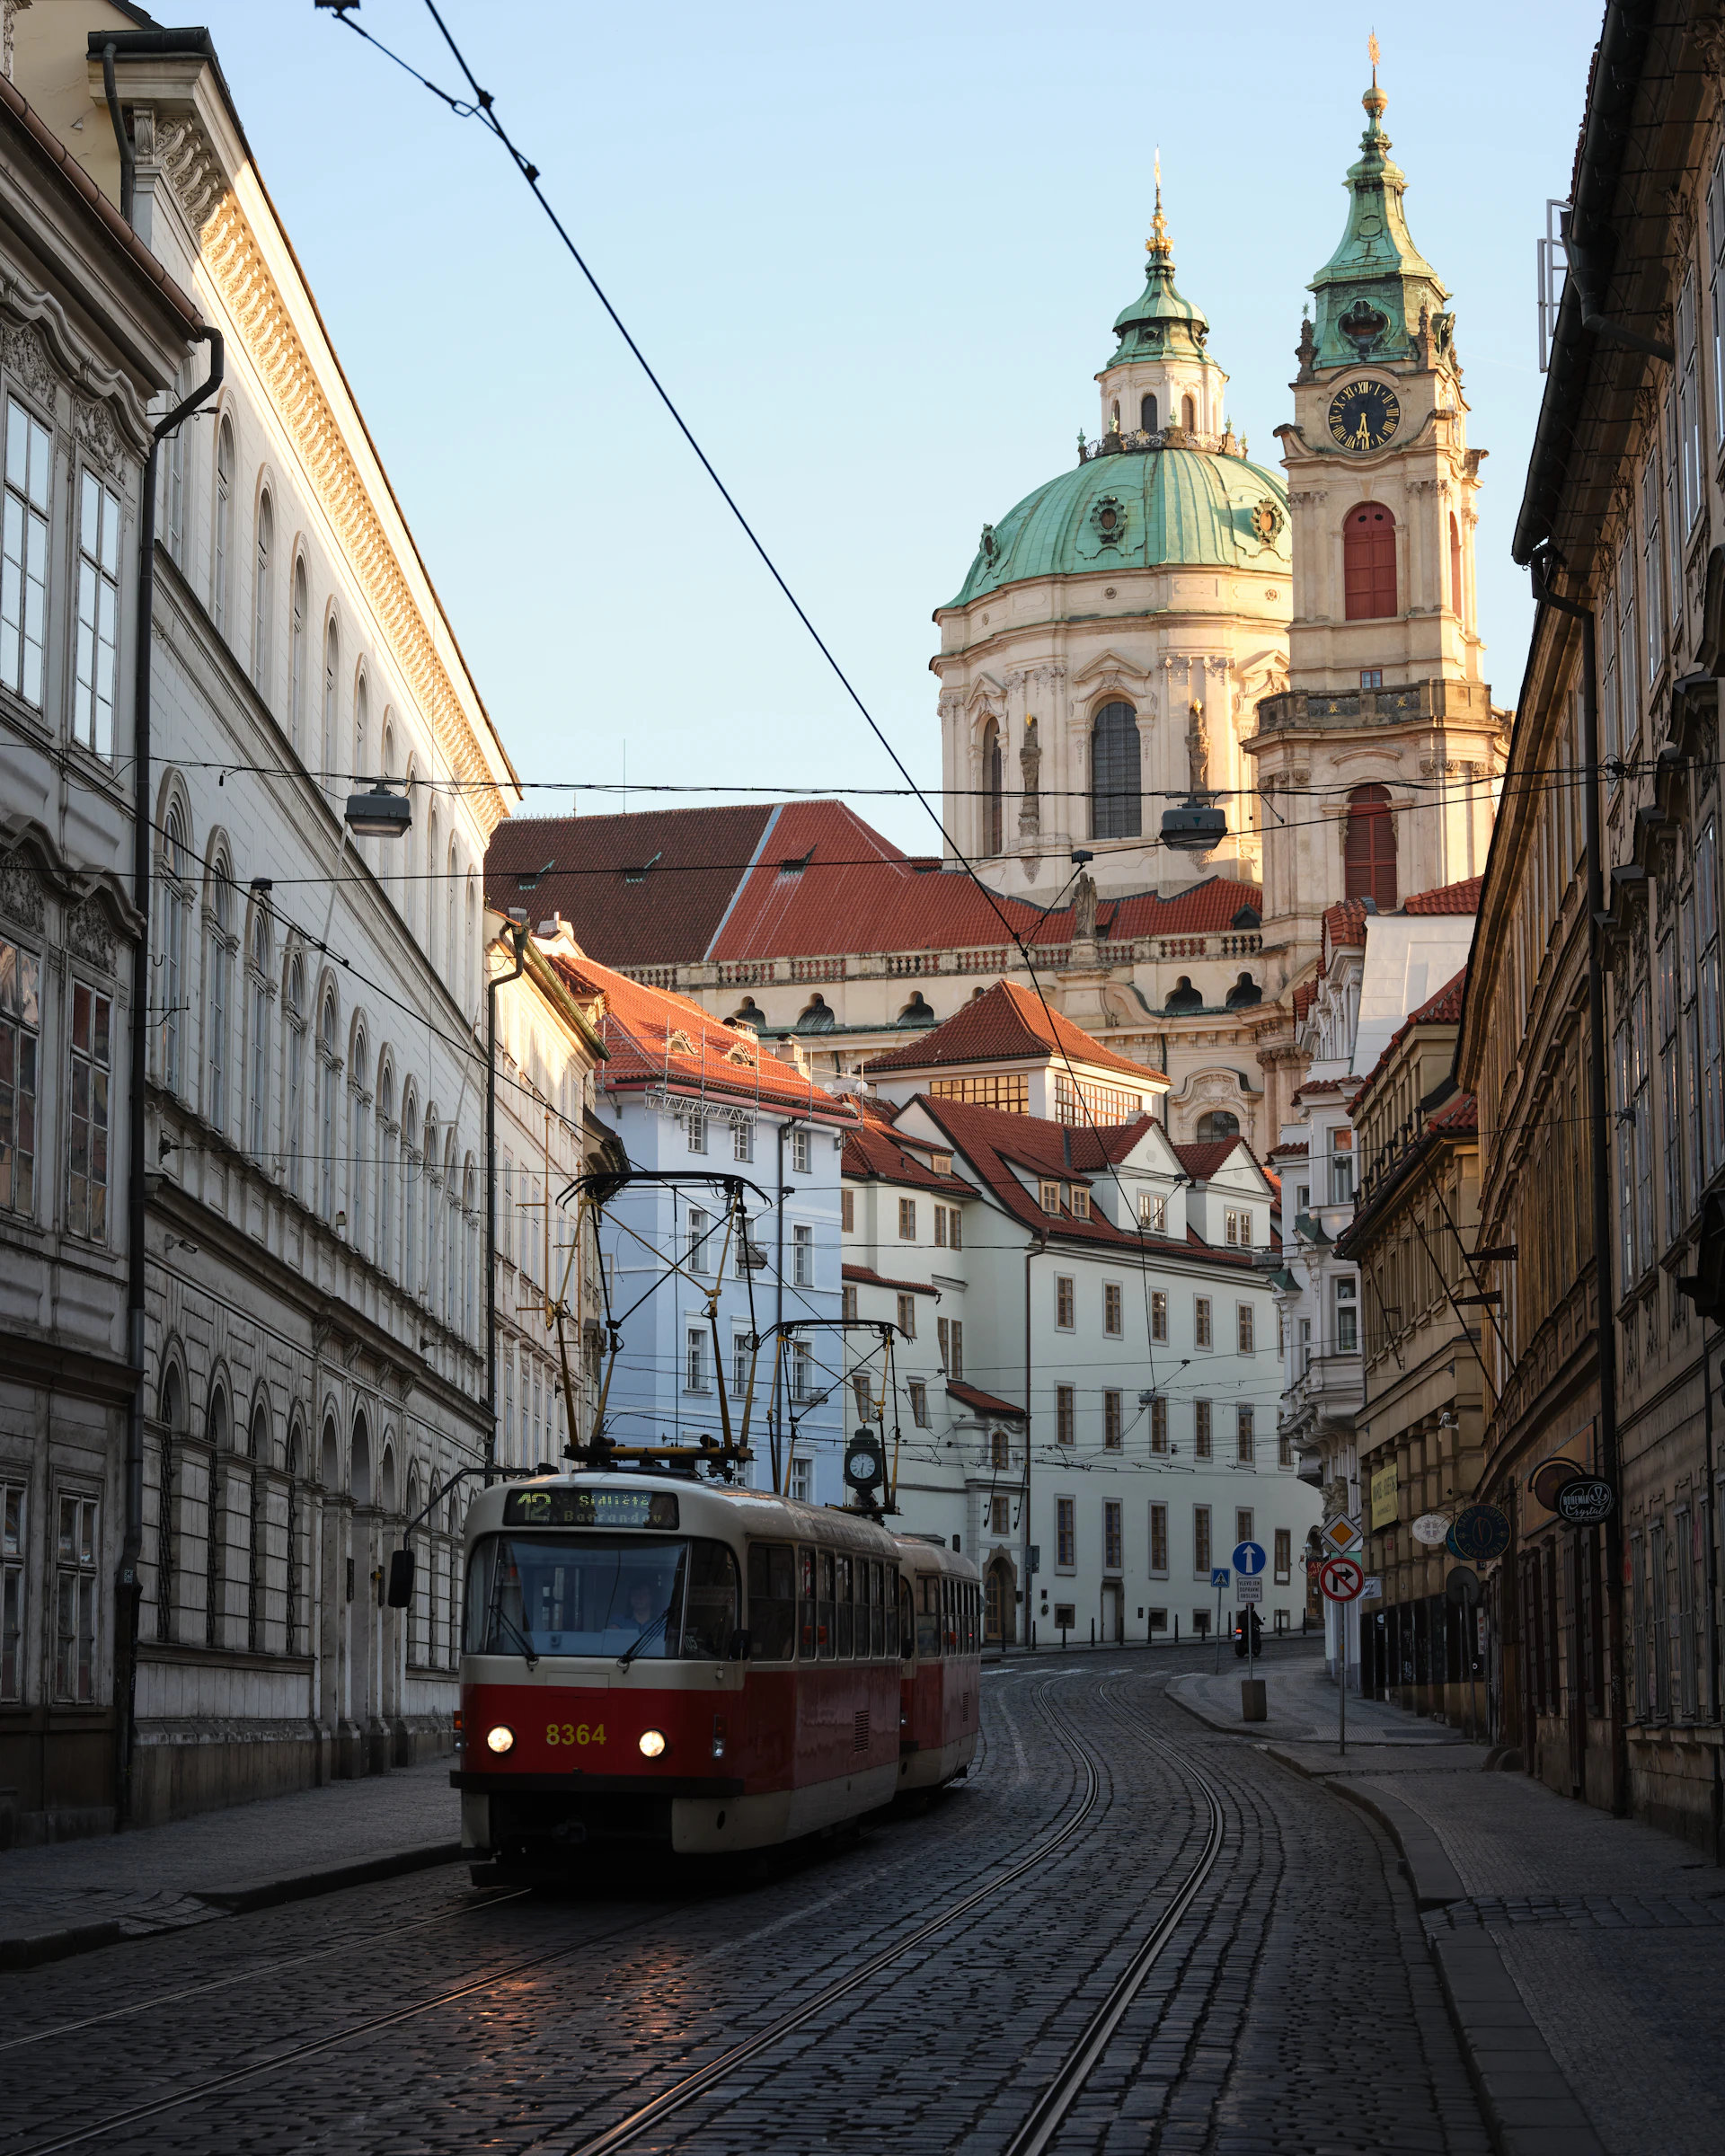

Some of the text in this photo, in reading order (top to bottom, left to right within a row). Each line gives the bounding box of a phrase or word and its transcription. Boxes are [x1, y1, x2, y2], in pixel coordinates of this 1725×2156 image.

[1358, 381, 1369, 394] XII
[517, 1492, 650, 1521] 12 Sídliště
[1563, 1494, 1590, 1507] BOHEMIA
[563, 1510, 662, 1524] Barrandov
[1457, 1506, 1507, 1528] SAINT TROPEZ
[546, 1723, 607, 1745] 8364
